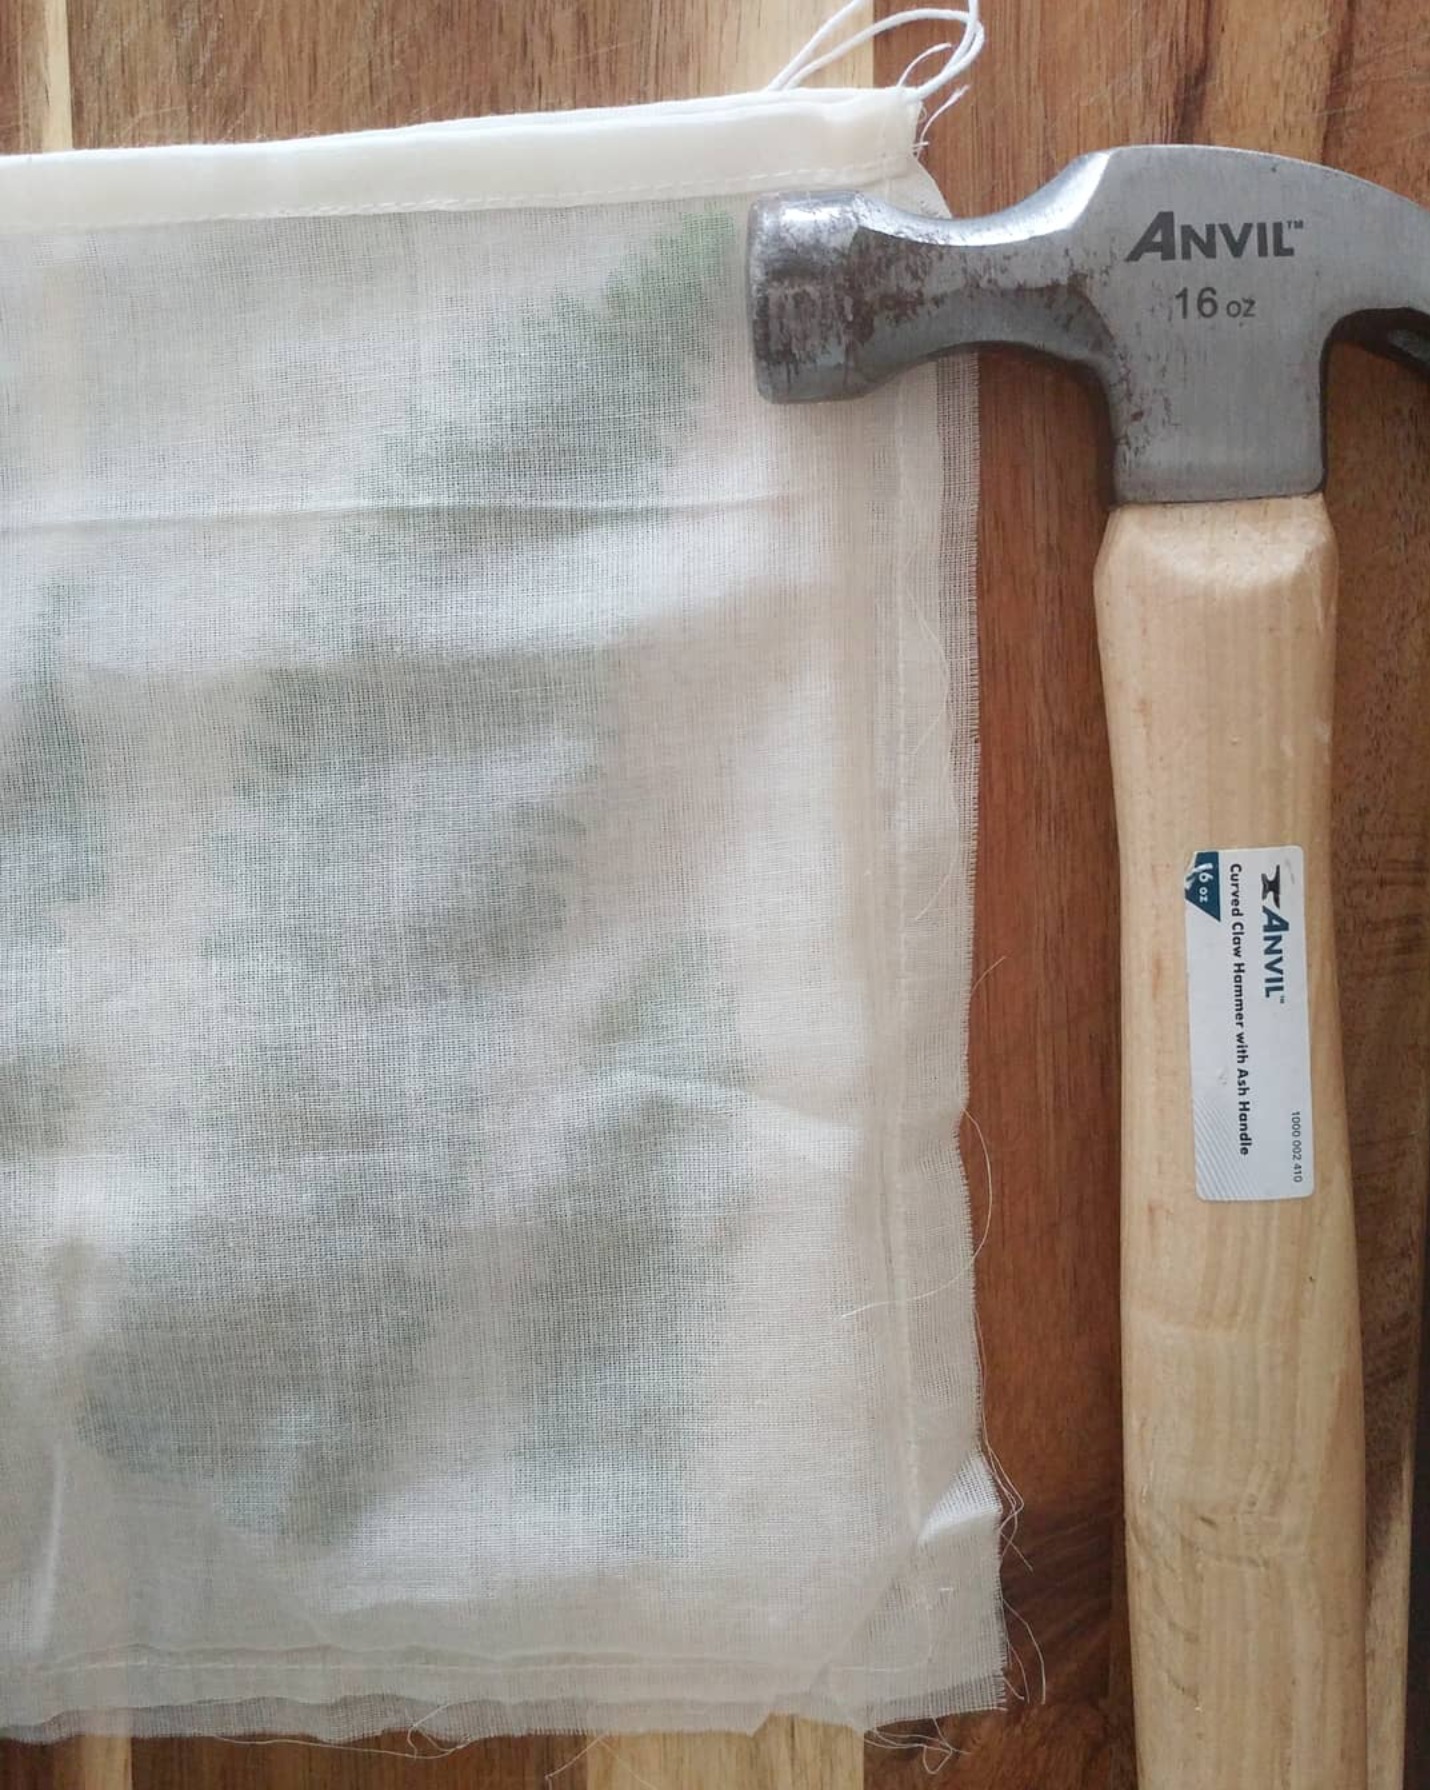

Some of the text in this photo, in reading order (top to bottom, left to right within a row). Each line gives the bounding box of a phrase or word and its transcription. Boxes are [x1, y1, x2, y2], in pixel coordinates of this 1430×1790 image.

[1174, 286, 1257, 320] 16 oz
[1198, 887, 1209, 903] oz
[1229, 863, 1252, 1155] Curved Claw Hammer with Ash Handle
[1291, 1111, 1302, 1138] 1000
[1292, 1140, 1302, 1161] 002
